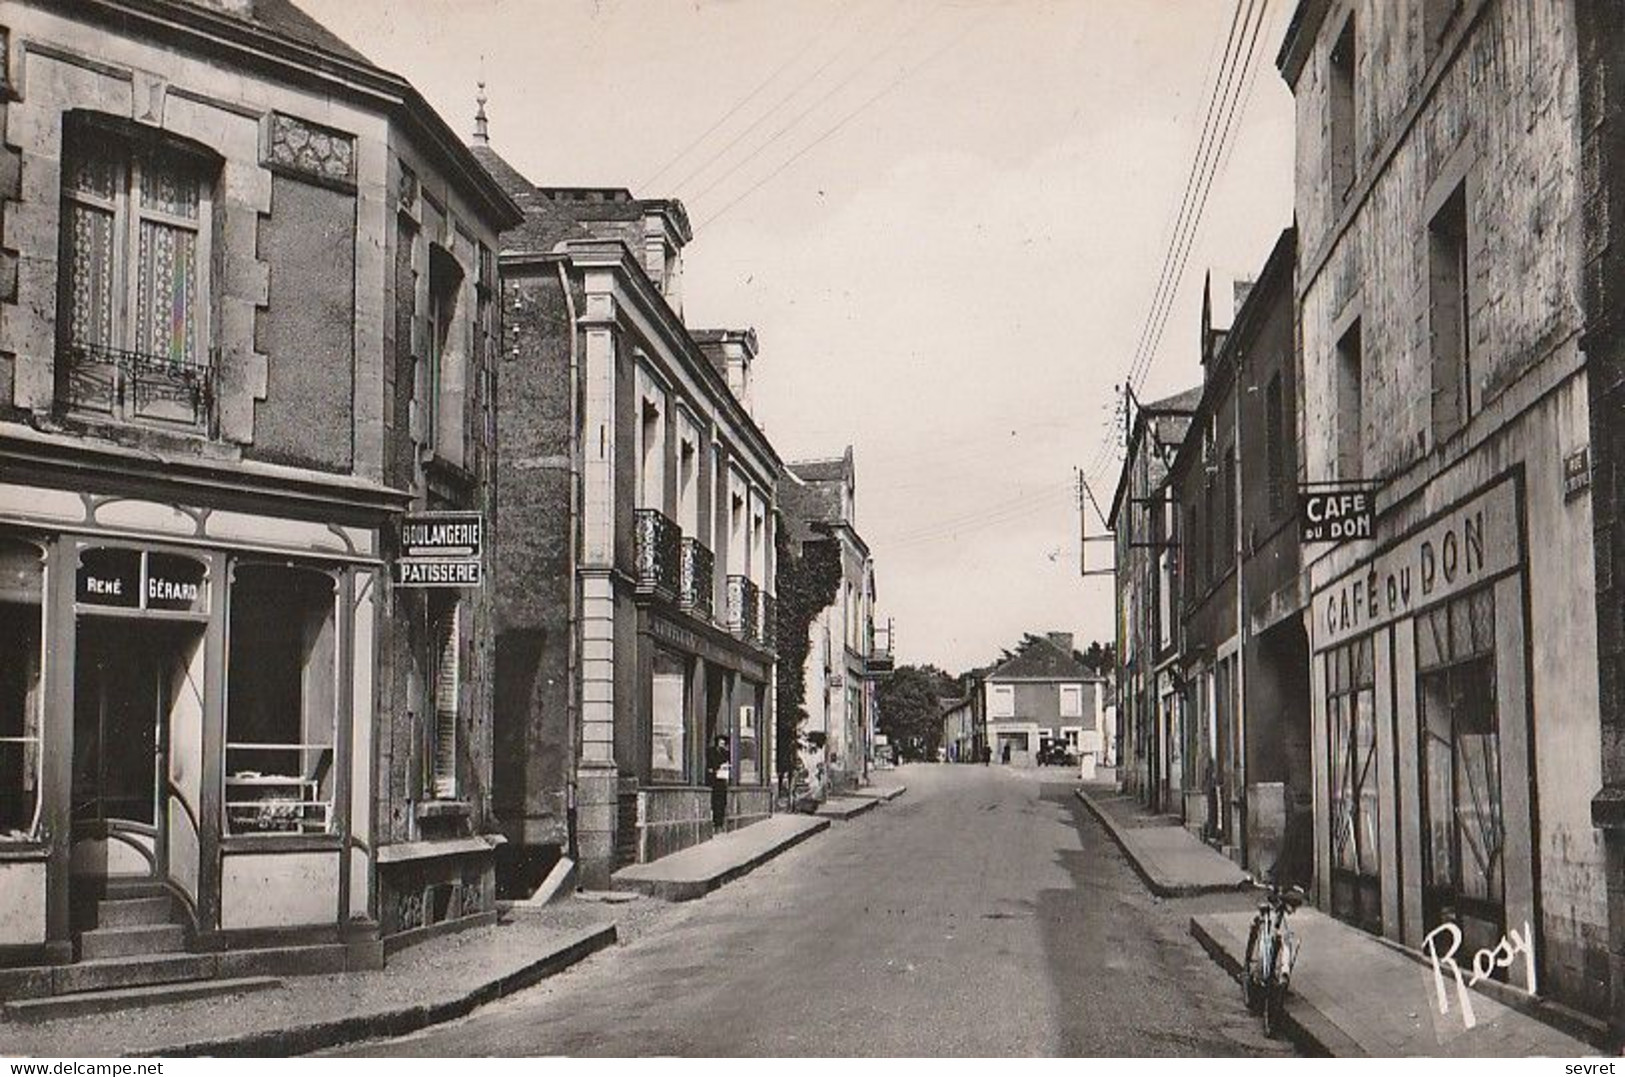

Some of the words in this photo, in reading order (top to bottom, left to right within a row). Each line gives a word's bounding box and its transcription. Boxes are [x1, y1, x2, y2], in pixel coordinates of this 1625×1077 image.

[402, 524, 478, 545] BOULANGERIE
[1305, 526, 1323, 539] DU
[1330, 513, 1371, 538] DON
[402, 564, 478, 582] PATISSERIE
[1326, 559, 1379, 636] CAFÉ
[1386, 566, 1411, 612] DU
[1420, 510, 1485, 596] DON
[87, 576, 122, 595] RENÉ
[149, 577, 198, 600] GÉRARD
